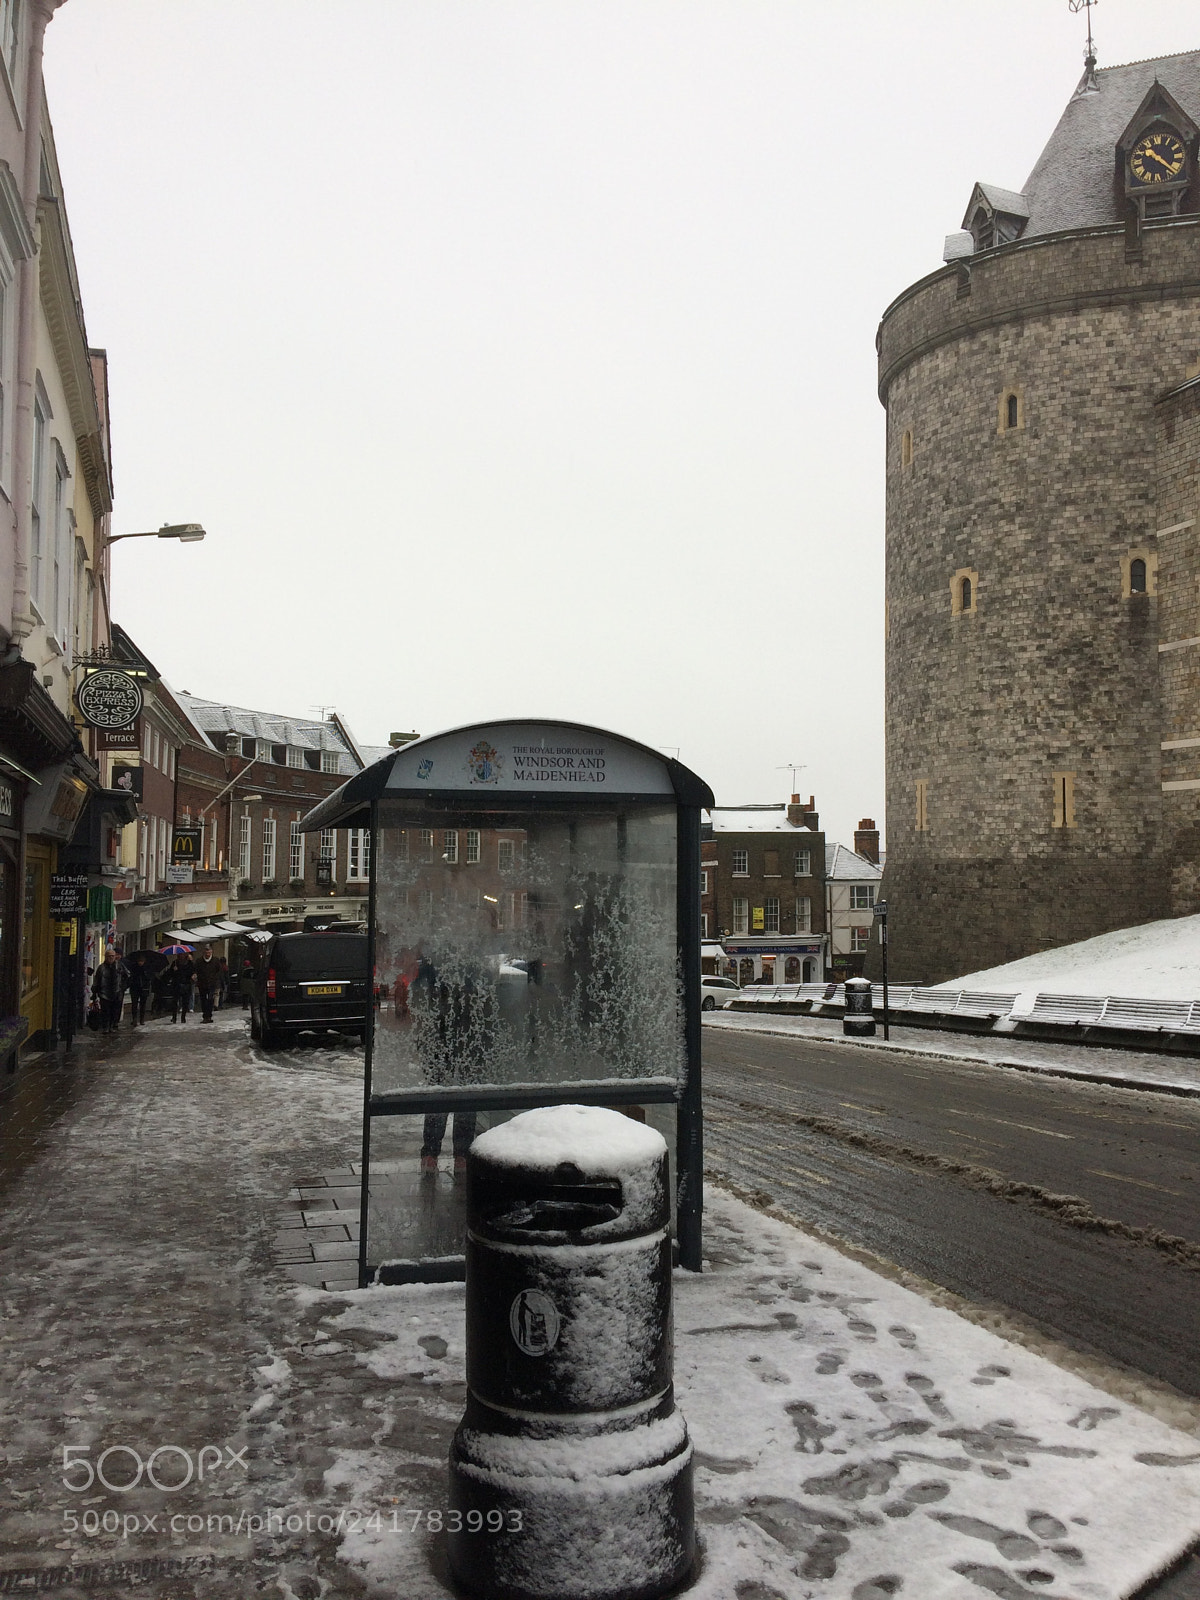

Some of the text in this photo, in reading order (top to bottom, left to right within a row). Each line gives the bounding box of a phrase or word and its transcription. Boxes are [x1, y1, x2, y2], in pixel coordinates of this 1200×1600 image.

[95, 690, 126, 699] PIZZA
[86, 696, 135, 707] EXPRESS
[104, 732, 135, 742] Terrace
[512, 746, 605, 756] THE ROYAL BOROUGH OF
[513, 756, 606, 769] WINDSOR AND
[513, 770, 606, 782] MAIDENHEAD
